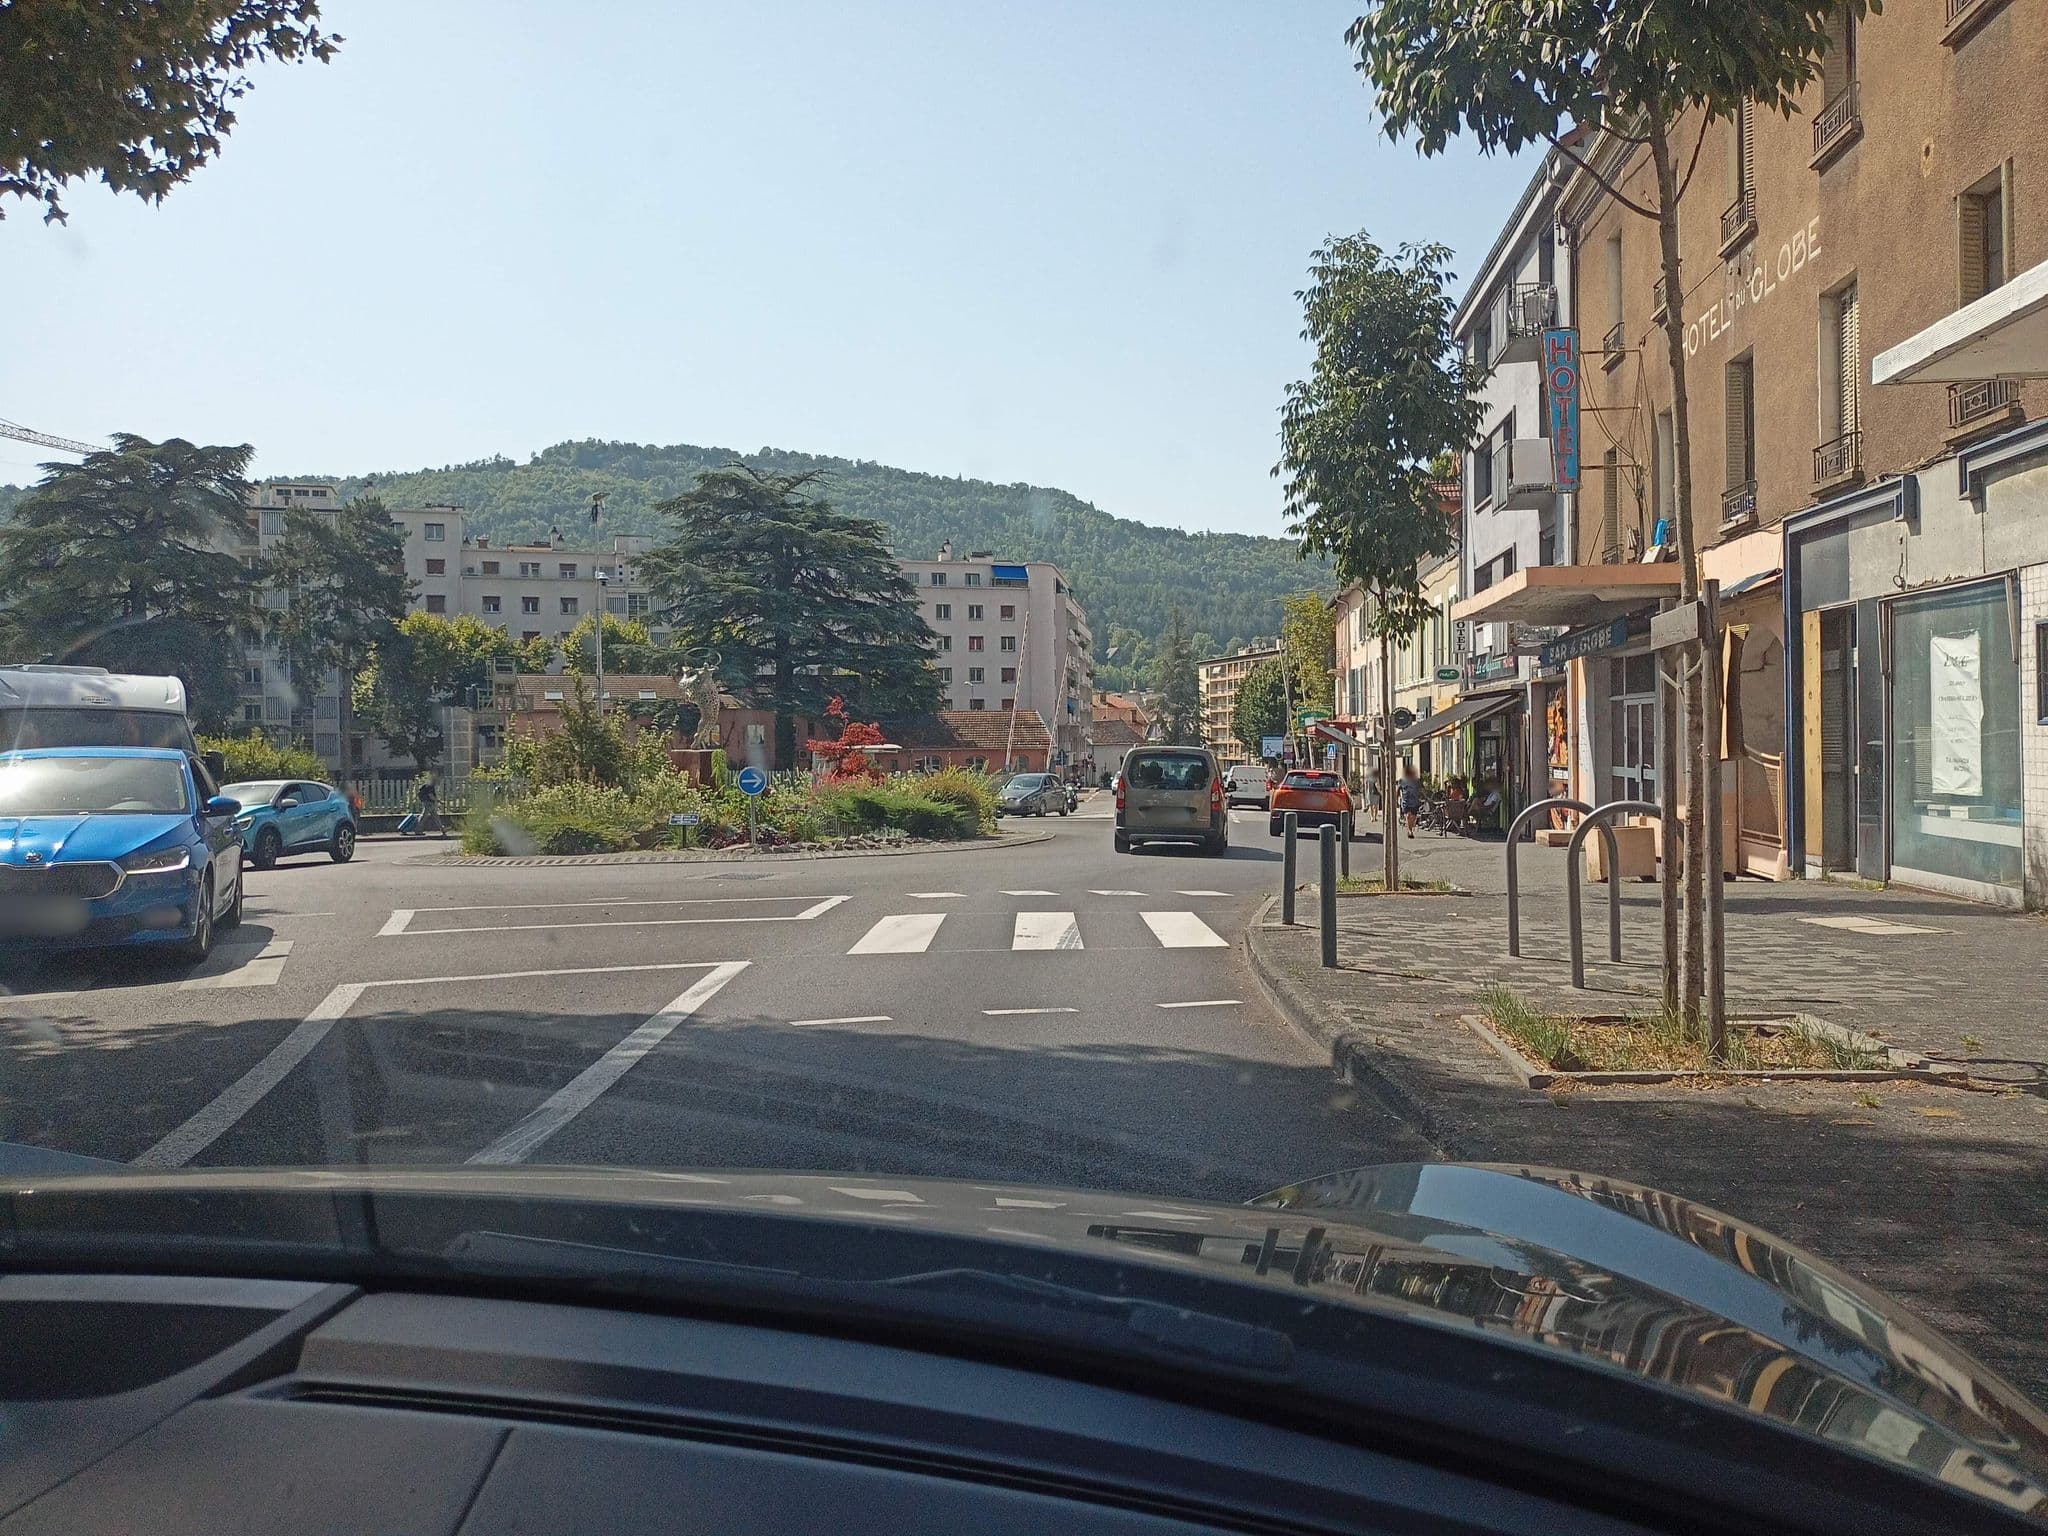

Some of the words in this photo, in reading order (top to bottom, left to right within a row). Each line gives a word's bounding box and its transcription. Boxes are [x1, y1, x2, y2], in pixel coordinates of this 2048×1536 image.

[1736, 288, 1746, 310] DU
[1751, 215, 1822, 304] GLOBE
[1551, 336, 1576, 485] HOTEL
[1456, 621, 1466, 651] OTEL
[1549, 643, 1567, 663] BAR
[1579, 625, 1612, 652] GLOBE
